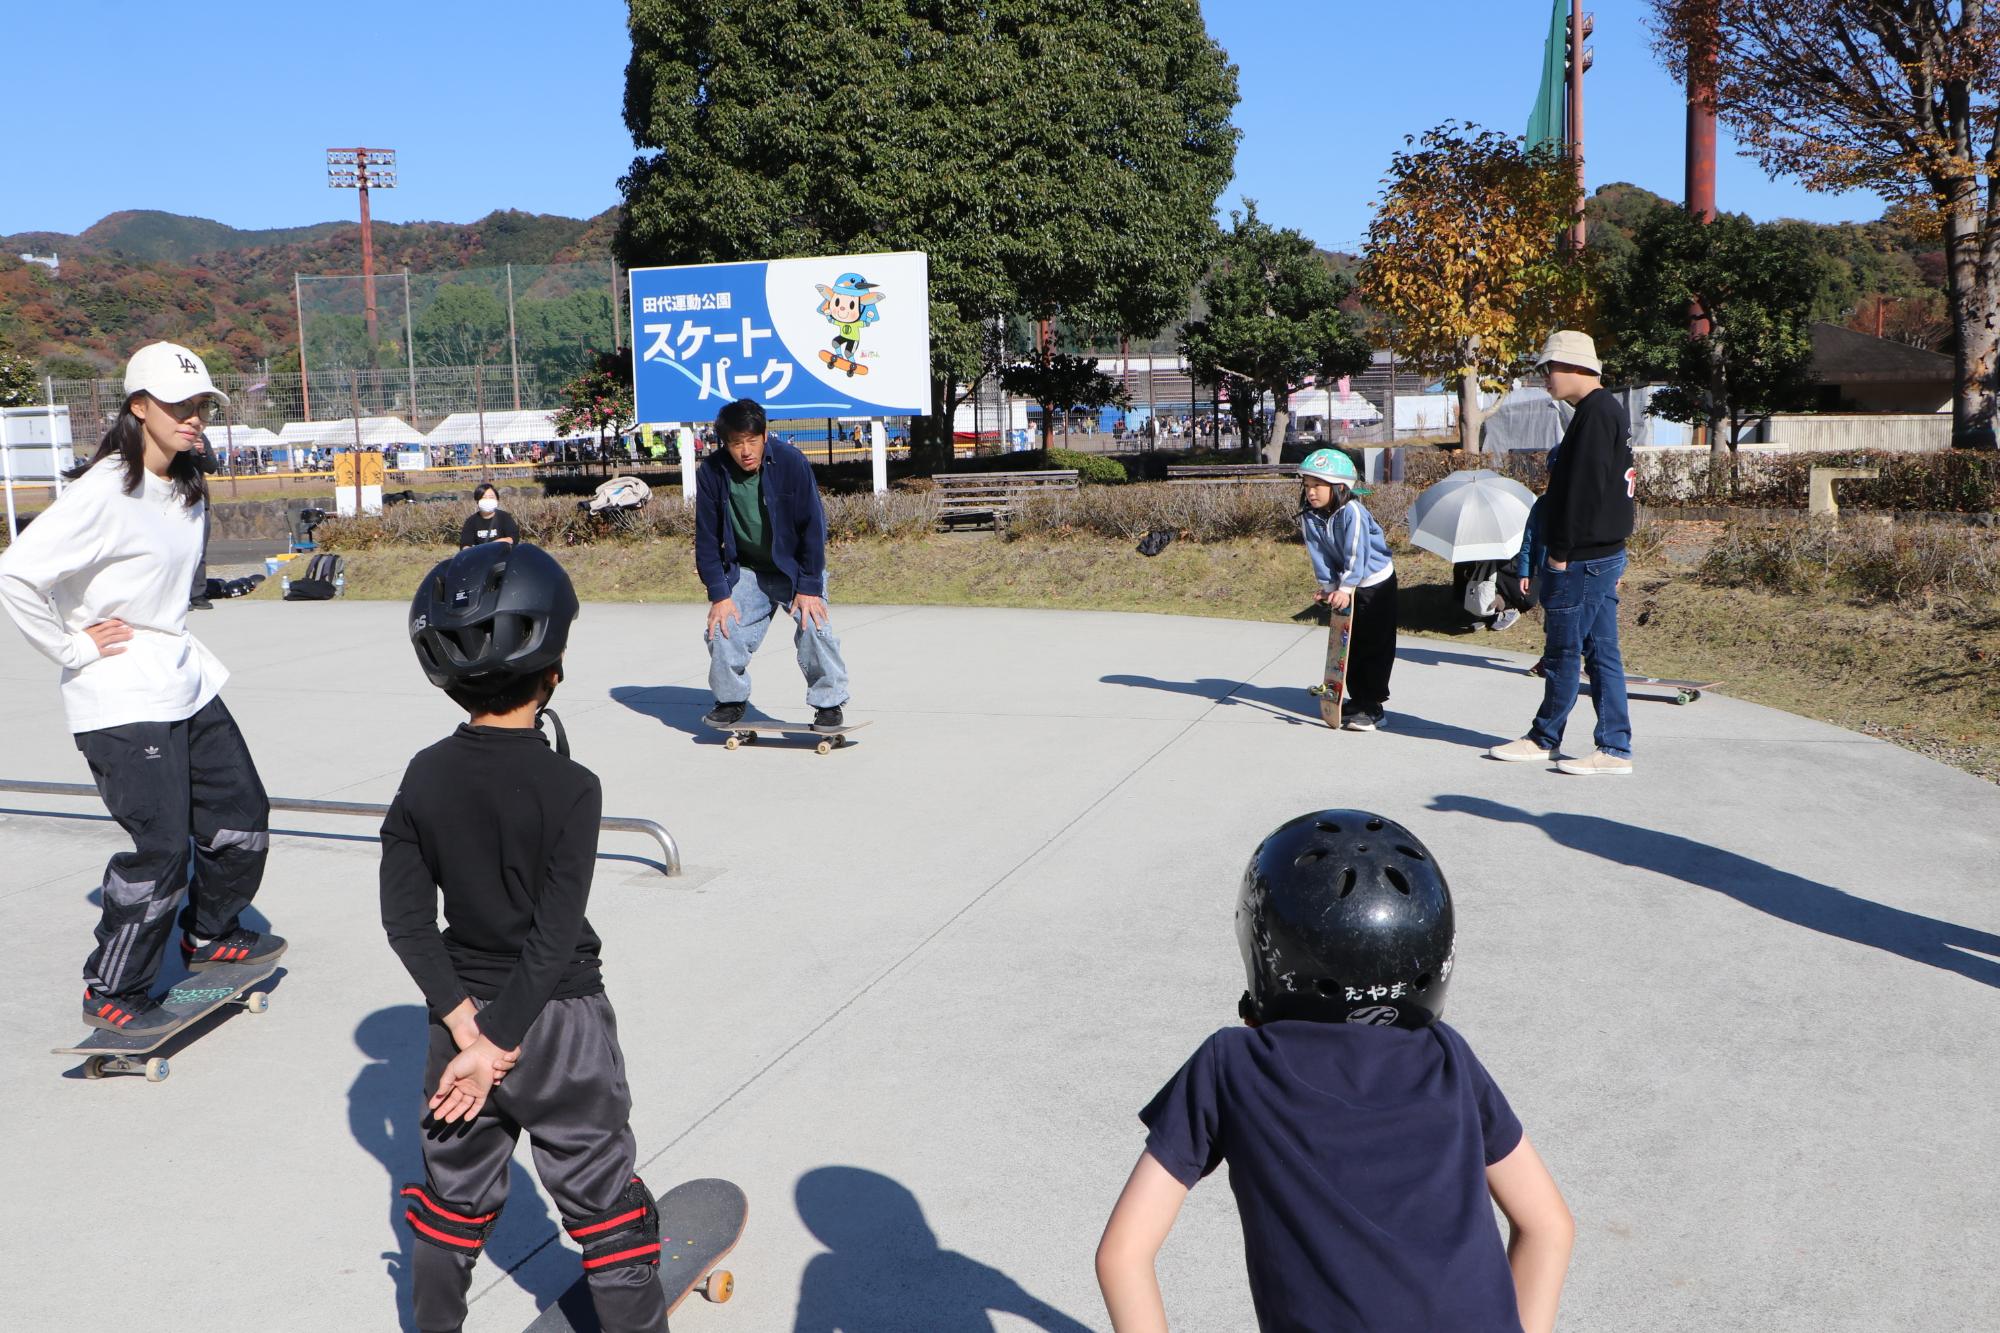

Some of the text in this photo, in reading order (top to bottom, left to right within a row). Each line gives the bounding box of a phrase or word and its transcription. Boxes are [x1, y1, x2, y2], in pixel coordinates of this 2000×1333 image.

[642, 292, 732, 313] 田代運動公園
[643, 317, 772, 362] スケート
[175, 354, 199, 374] LA
[697, 357, 793, 400] パーク
